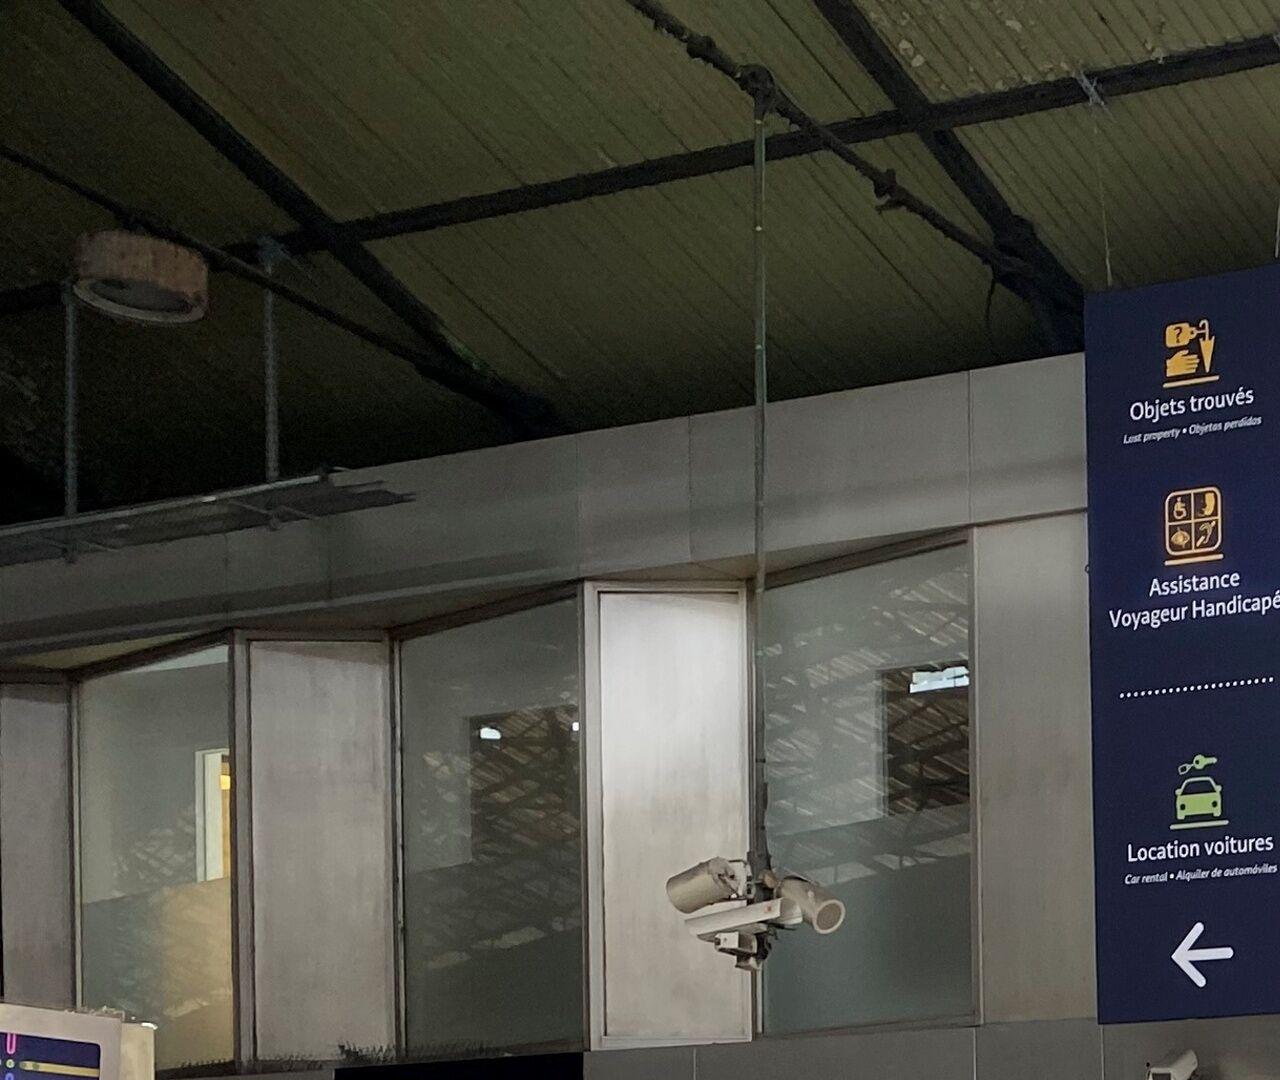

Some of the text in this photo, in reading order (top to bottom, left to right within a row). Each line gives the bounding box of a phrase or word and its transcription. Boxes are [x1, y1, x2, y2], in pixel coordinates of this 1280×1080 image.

[1130, 387, 1254, 423] Objets trouvés
[1149, 571, 1240, 597] Assistance
[1109, 604, 1188, 630] Voyageur
[1127, 835, 1273, 862] Location voitures
[1125, 867, 1222, 885] Car rental Alquiler de
